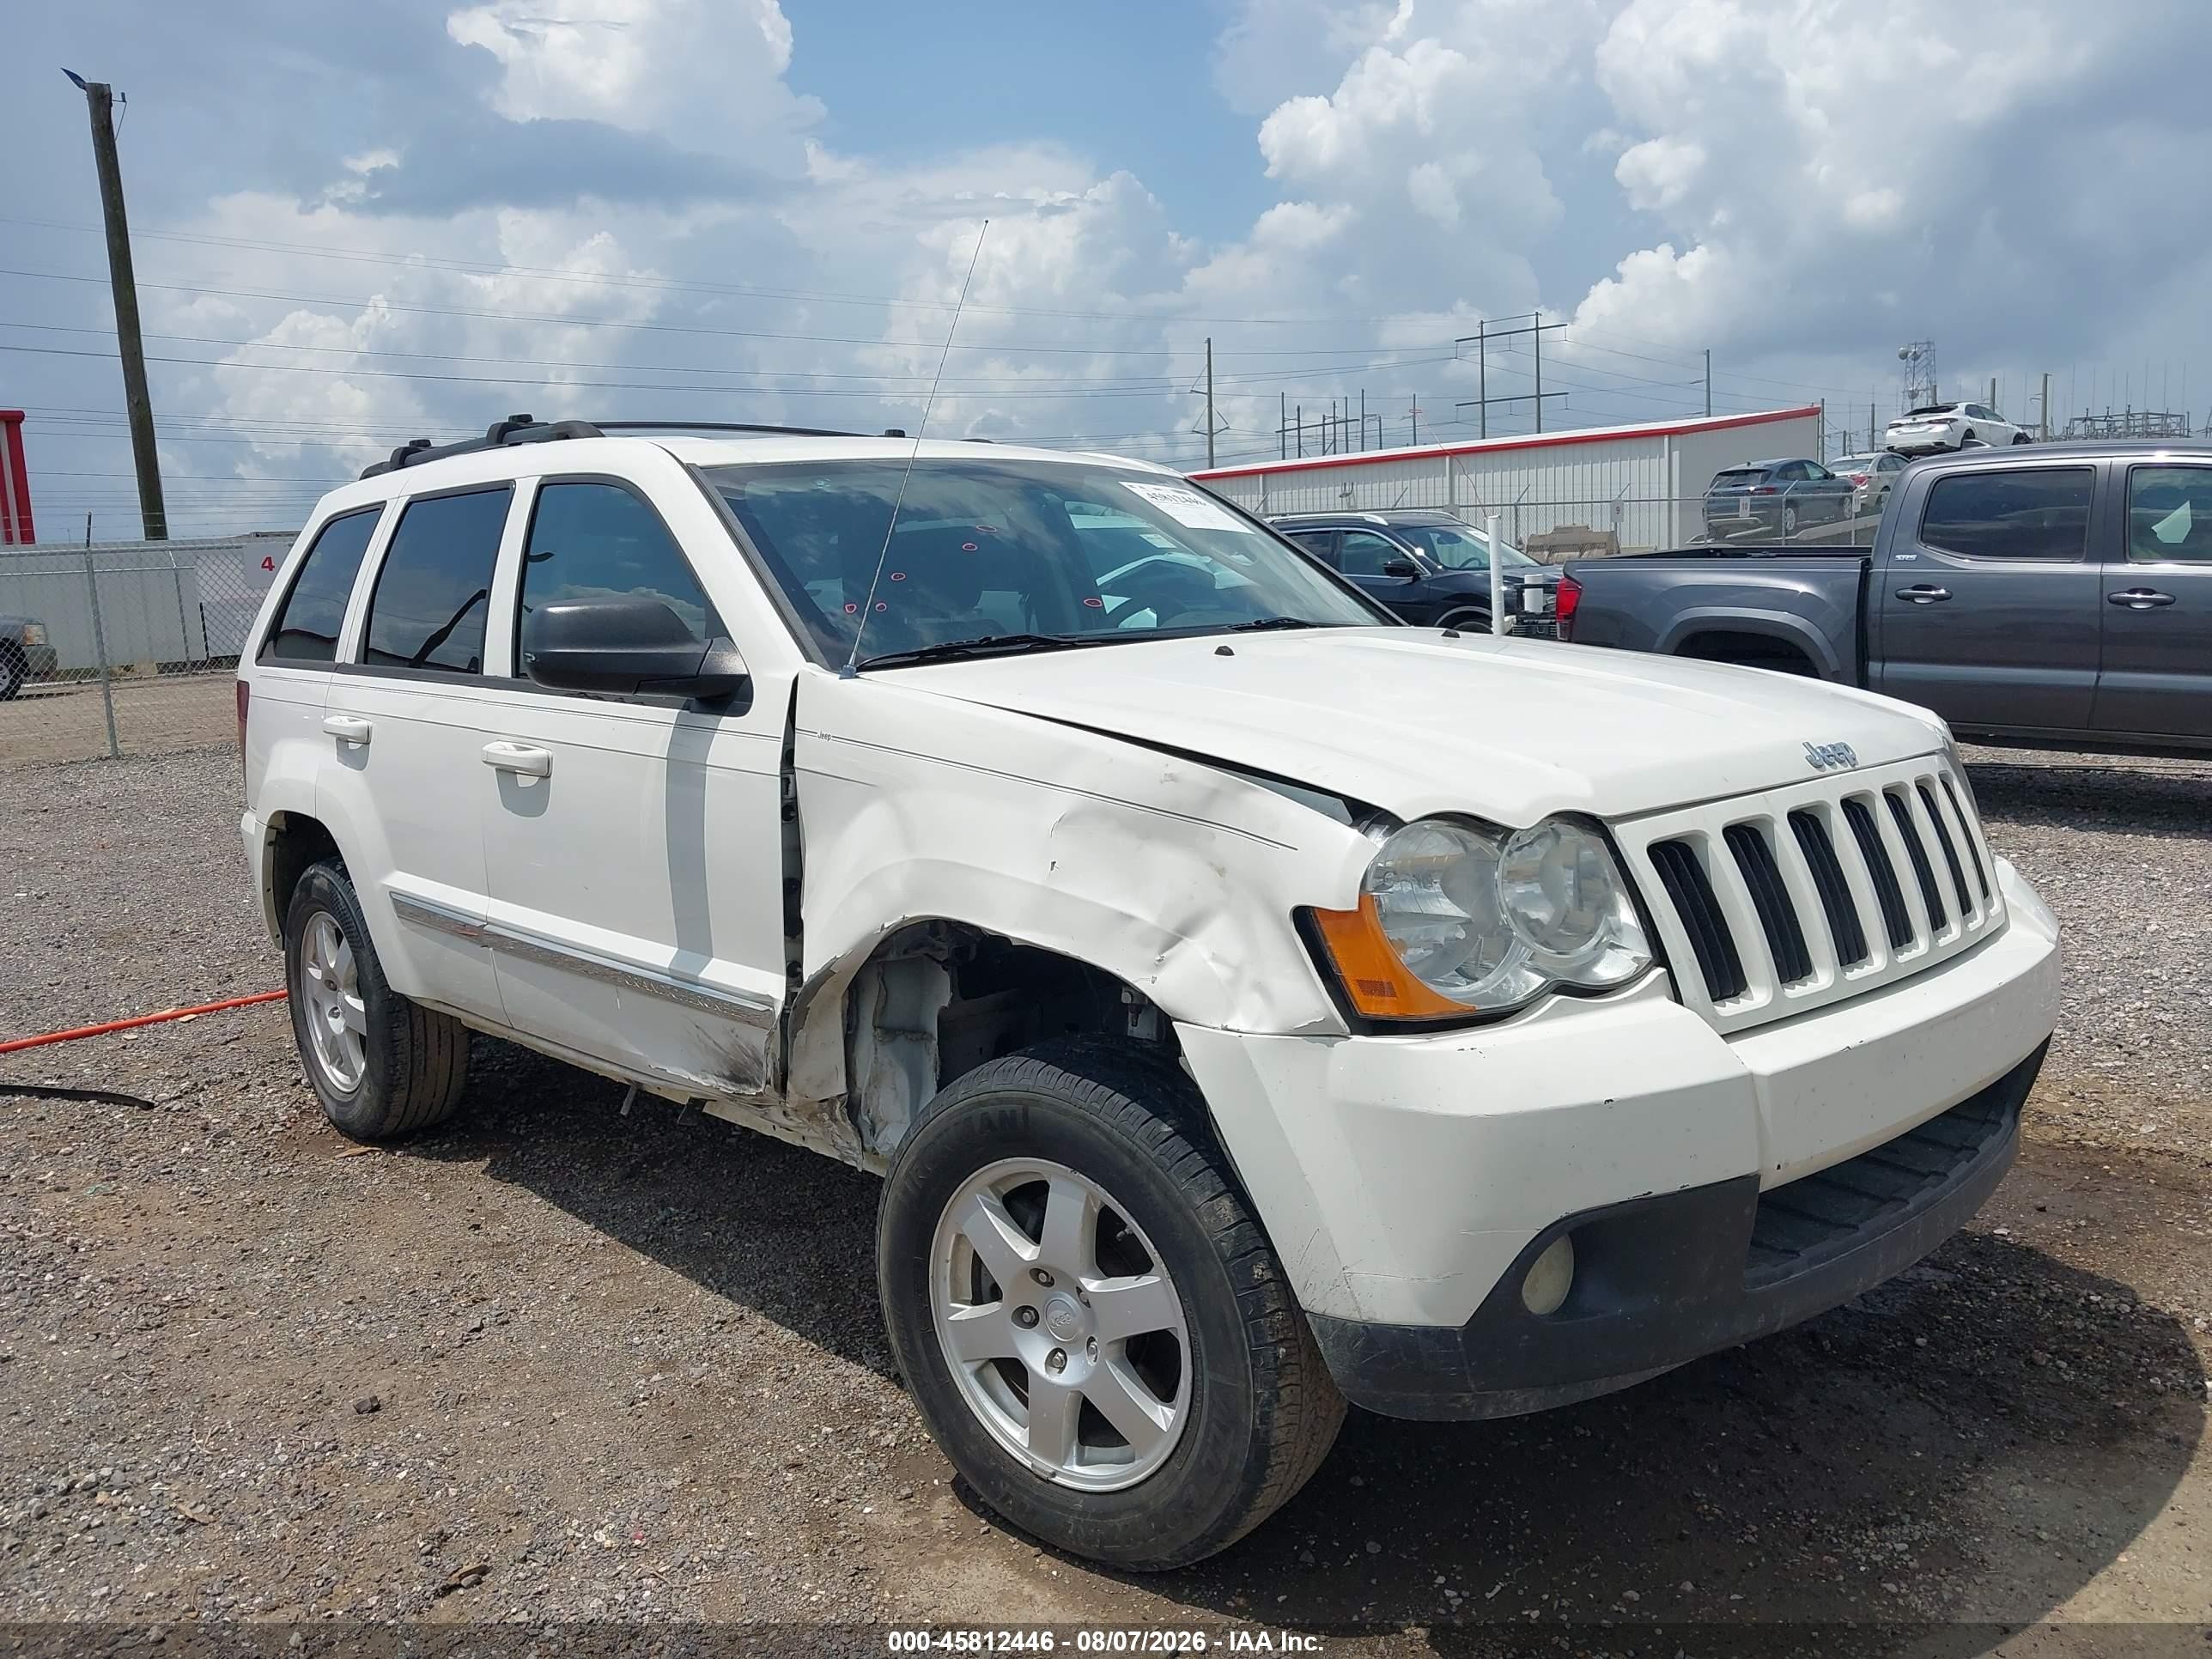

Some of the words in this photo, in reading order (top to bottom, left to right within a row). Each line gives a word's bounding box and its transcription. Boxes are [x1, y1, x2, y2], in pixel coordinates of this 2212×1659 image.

[1615, 506, 1620, 515] 9
[261, 556, 276, 572] 4
[817, 729, 831, 742] Jeep
[1802, 741, 1856, 769] Jeep
[1050, 1312, 1073, 1329] Jeep
